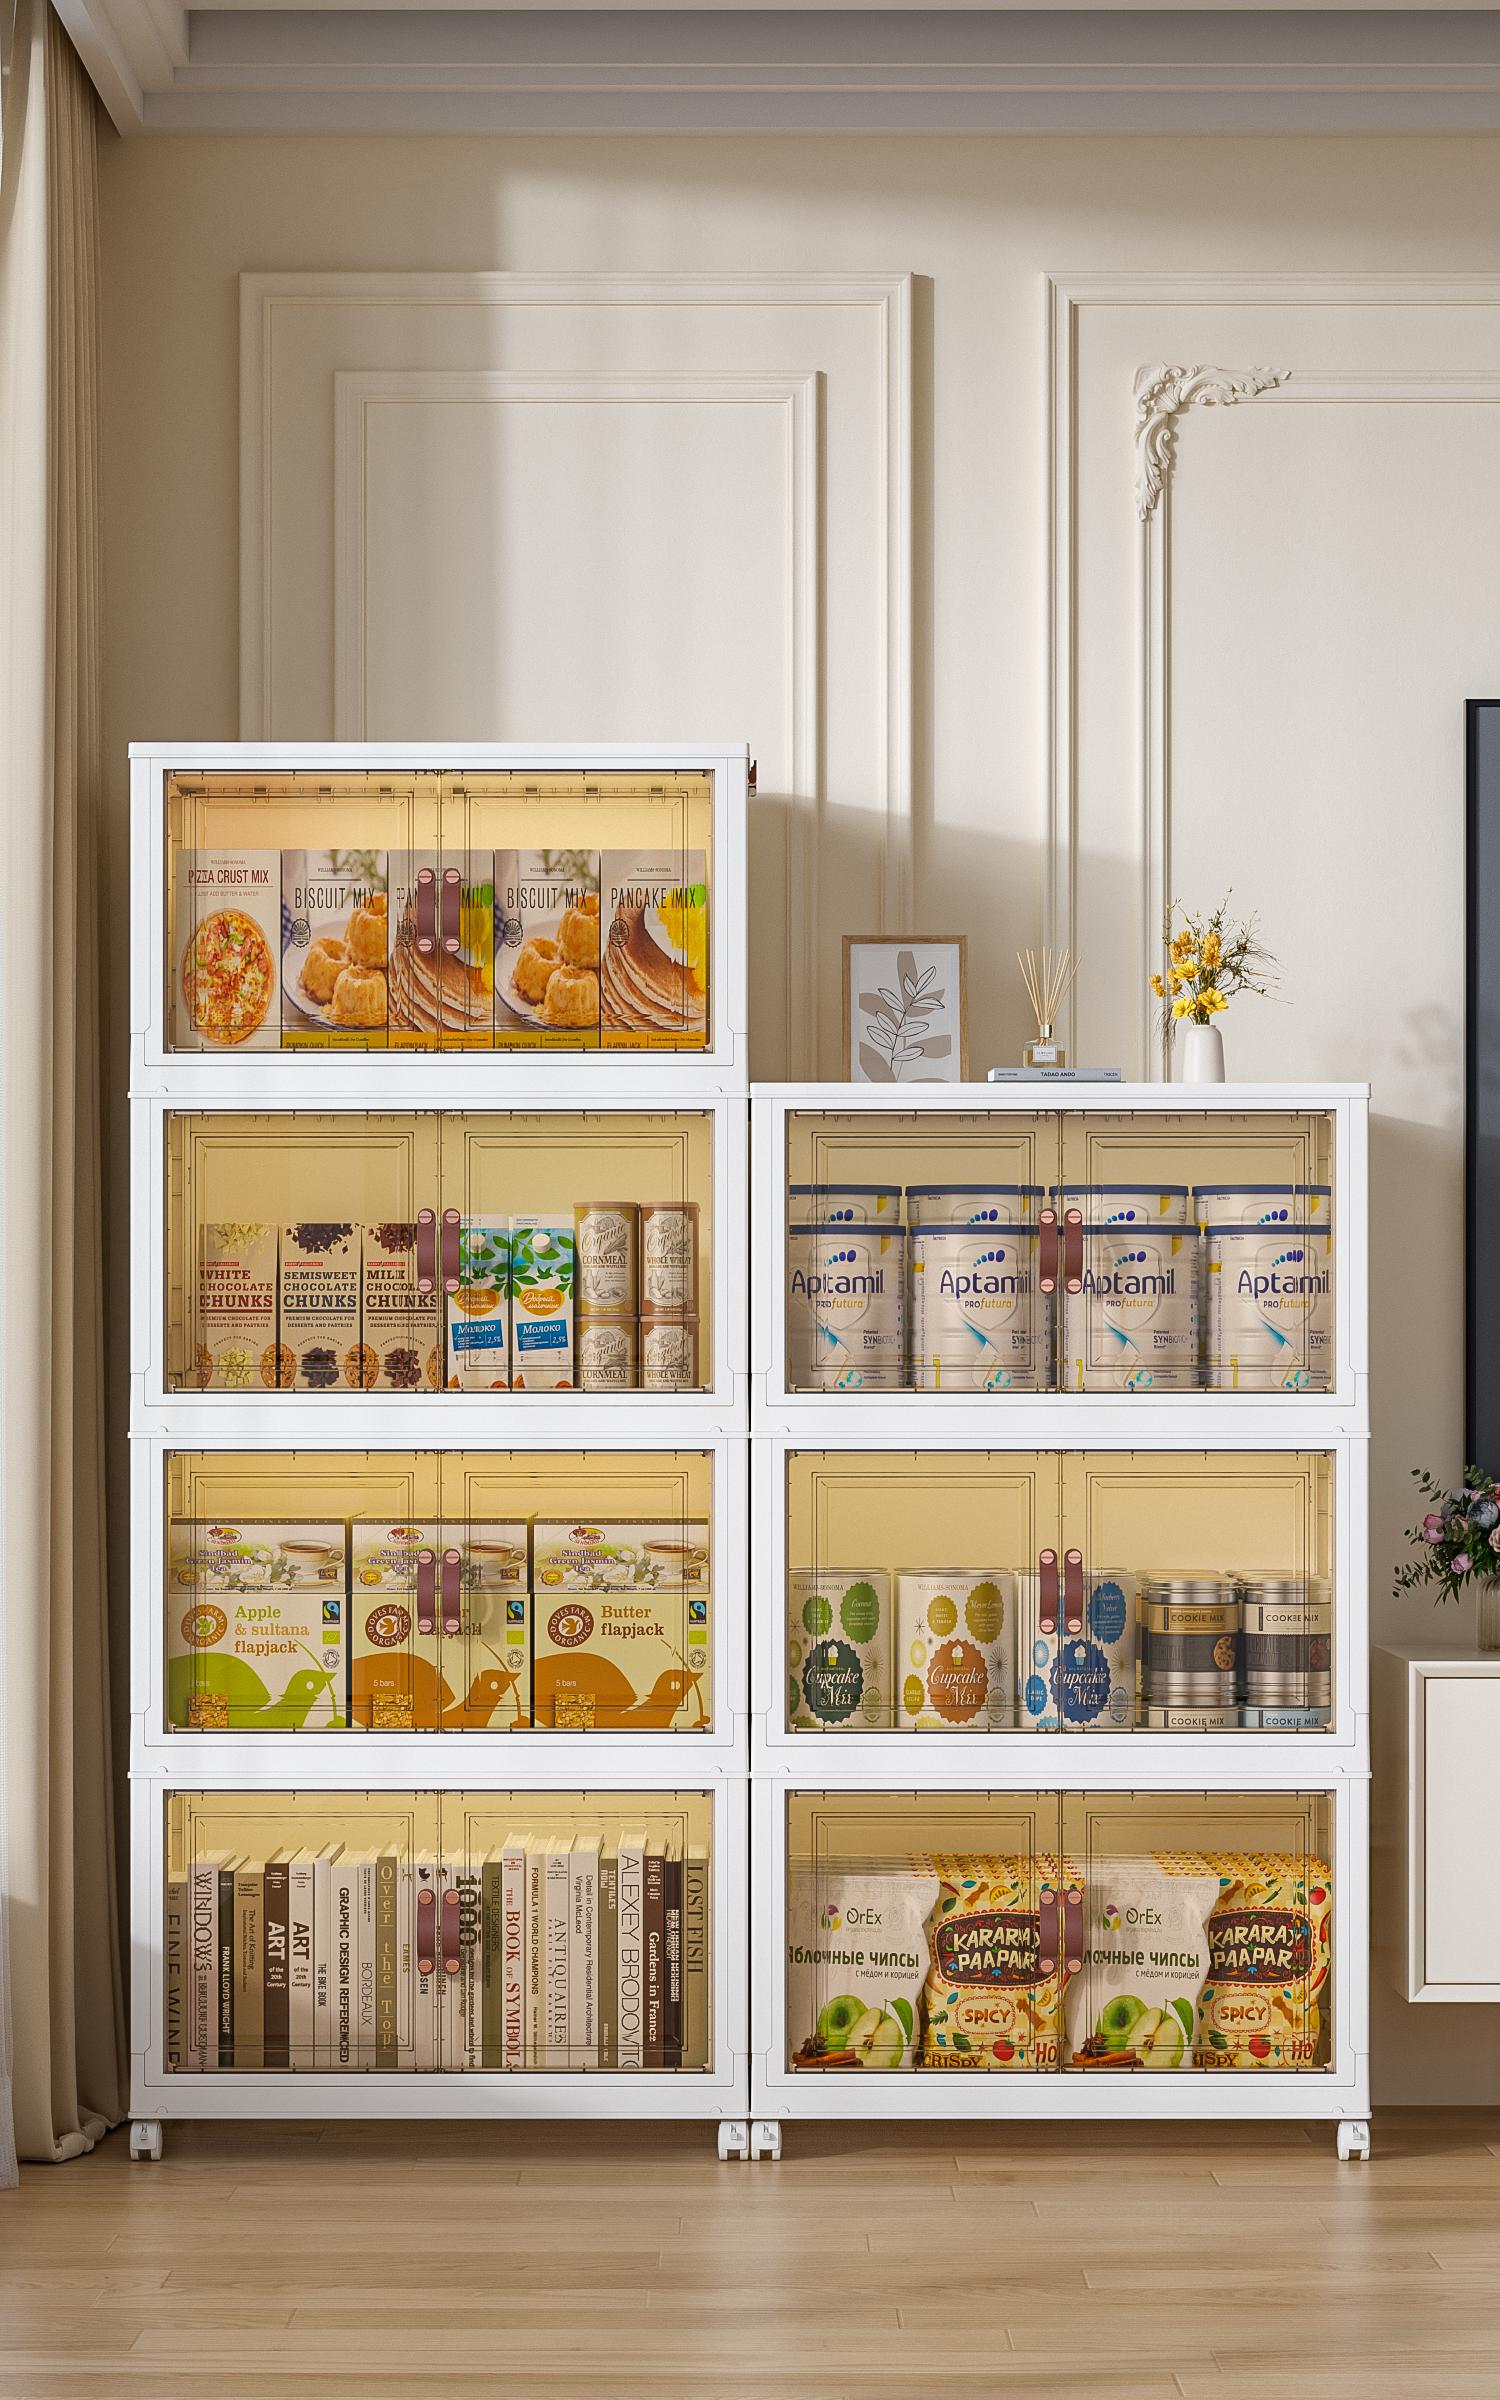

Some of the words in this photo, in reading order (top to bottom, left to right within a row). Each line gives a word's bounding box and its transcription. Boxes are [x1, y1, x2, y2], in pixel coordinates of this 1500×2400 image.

[217, 869, 249, 884] CRUST
[251, 869, 269, 884] MIX
[294, 887, 347, 909] BISCUIT
[353, 887, 375, 909] MIX
[507, 887, 559, 909] BISCUIT
[565, 887, 588, 909] MIX
[611, 887, 667, 909] PANCAKE
[582, 1255, 628, 1265] CORNMEAL
[199, 1269, 251, 1280] WHITE
[283, 1271, 358, 1280] SEMISWEET
[366, 1269, 406, 1280] MILK
[199, 1283, 273, 1292] CHOCOLATE
[283, 1283, 357, 1292] CHOCOLATE
[366, 1283, 419, 1292] CHOCOL
[791, 1268, 884, 1300] Aptamil
[940, 1268, 1030, 1300] Aptamil
[1082, 1268, 1176, 1300] Aptamil
[1238, 1268, 1330, 1300] Aptamil
[199, 1294, 273, 1308] CHUNKS
[283, 1294, 357, 1308] CHUNKS
[365, 1294, 437, 1308] CHUNKS
[964, 1297, 1012, 1310] PROfutura
[1106, 1297, 1154, 1310] PROfutura
[522, 1324, 561, 1335] Молоко
[582, 1369, 628, 1379] CORNMEAL
[548, 1557, 578, 1565] Green
[561, 1549, 603, 1557] Sindbad
[917, 1583, 969, 1591] WILLIAMS-SONOMA
[234, 1605, 281, 1621] Apple
[550, 1607, 569, 1633] DOVES
[570, 1606, 591, 1623] FARM
[600, 1605, 652, 1618] Butter
[1170, 1614, 1207, 1622] COOKIE
[1209, 1614, 1225, 1622] MIX
[234, 1624, 247, 1636] &
[251, 1623, 310, 1636] sultana
[554, 1626, 591, 1646] ORGANIC
[600, 1622, 665, 1639] flapjack
[234, 1640, 298, 1657] flapjack
[379, 1679, 394, 1687] bars
[561, 1679, 577, 1687] bars
[930, 1665, 984, 1689] Cupcake
[1170, 1717, 1207, 1726] COOKIE
[1209, 1717, 1225, 1726] MIX
[1265, 1717, 1302, 1726] COOKIE
[1304, 1717, 1319, 1725] MIX
[491, 1875, 499, 1906] TEXTILE
[531, 1867, 539, 1907] FORMULA
[574, 1875, 583, 1903] Virginia
[585, 1874, 593, 1896] Detail
[687, 1866, 704, 1920] LOST
[505, 1887, 513, 1906] THE
[585, 1897, 593, 1905] in
[621, 1854, 639, 1941] ALEXEY
[193, 1869, 213, 1972] WINDOWS
[248, 1909, 256, 1922] The
[338, 1887, 350, 1939] GRAPHIC
[575, 1904, 583, 1934] McLeod
[846, 1907, 882, 1925] OrEx
[1126, 1907, 1162, 1925] OrEx
[248, 1923, 256, 1934] Art
[491, 1908, 499, 1951] DESIGNERS
[505, 1910, 521, 1962] BOOK
[531, 1914, 539, 1945] WORLD
[583, 1906, 593, 1958] Contemporary
[268, 1921, 286, 1960] ART
[292, 1921, 310, 1960] ART
[222, 1946, 230, 1972] FRANK
[247, 1943, 256, 1970] Knitting
[402, 1943, 410, 1973] EAMES
[648, 1931, 660, 1982] Gardens
[687, 1927, 704, 1973] FISH
[869, 1951, 919, 1967] чипсы
[1083, 1949, 1145, 1965] лочные
[1149, 1951, 1200, 1967] чипсы
[1213, 1947, 1294, 1970] PAAPAR
[317, 1963, 327, 1977] THE
[338, 1942, 350, 1985] DESIGN
[505, 1966, 513, 1979] OF
[531, 1946, 539, 1995] CHAMPIONS
[552, 1918, 567, 2044] ANTIQUAIRES
[585, 1959, 593, 2000] Residential
[860, 1969, 883, 1979] мёдом
[884, 1970, 889, 1978] и
[890, 1970, 919, 1980] корицей
[1140, 1969, 1163, 1978] мёдом
[1164, 1970, 1169, 1978] и
[1170, 1970, 1200, 1980] корицей
[222, 1973, 230, 2000] LLOYD
[317, 1978, 327, 1991] BIKE
[649, 1984, 660, 1997] in
[317, 1991, 327, 2007] BOOK
[361, 1962, 373, 2026] BORDEAUX
[222, 2001, 230, 2034] WRIGHT
[649, 2000, 660, 2042] France
[964, 2007, 1011, 2024] SPICY
[1220, 2005, 1267, 2022] SPICY
[924, 2052, 984, 2068] CRISPY
